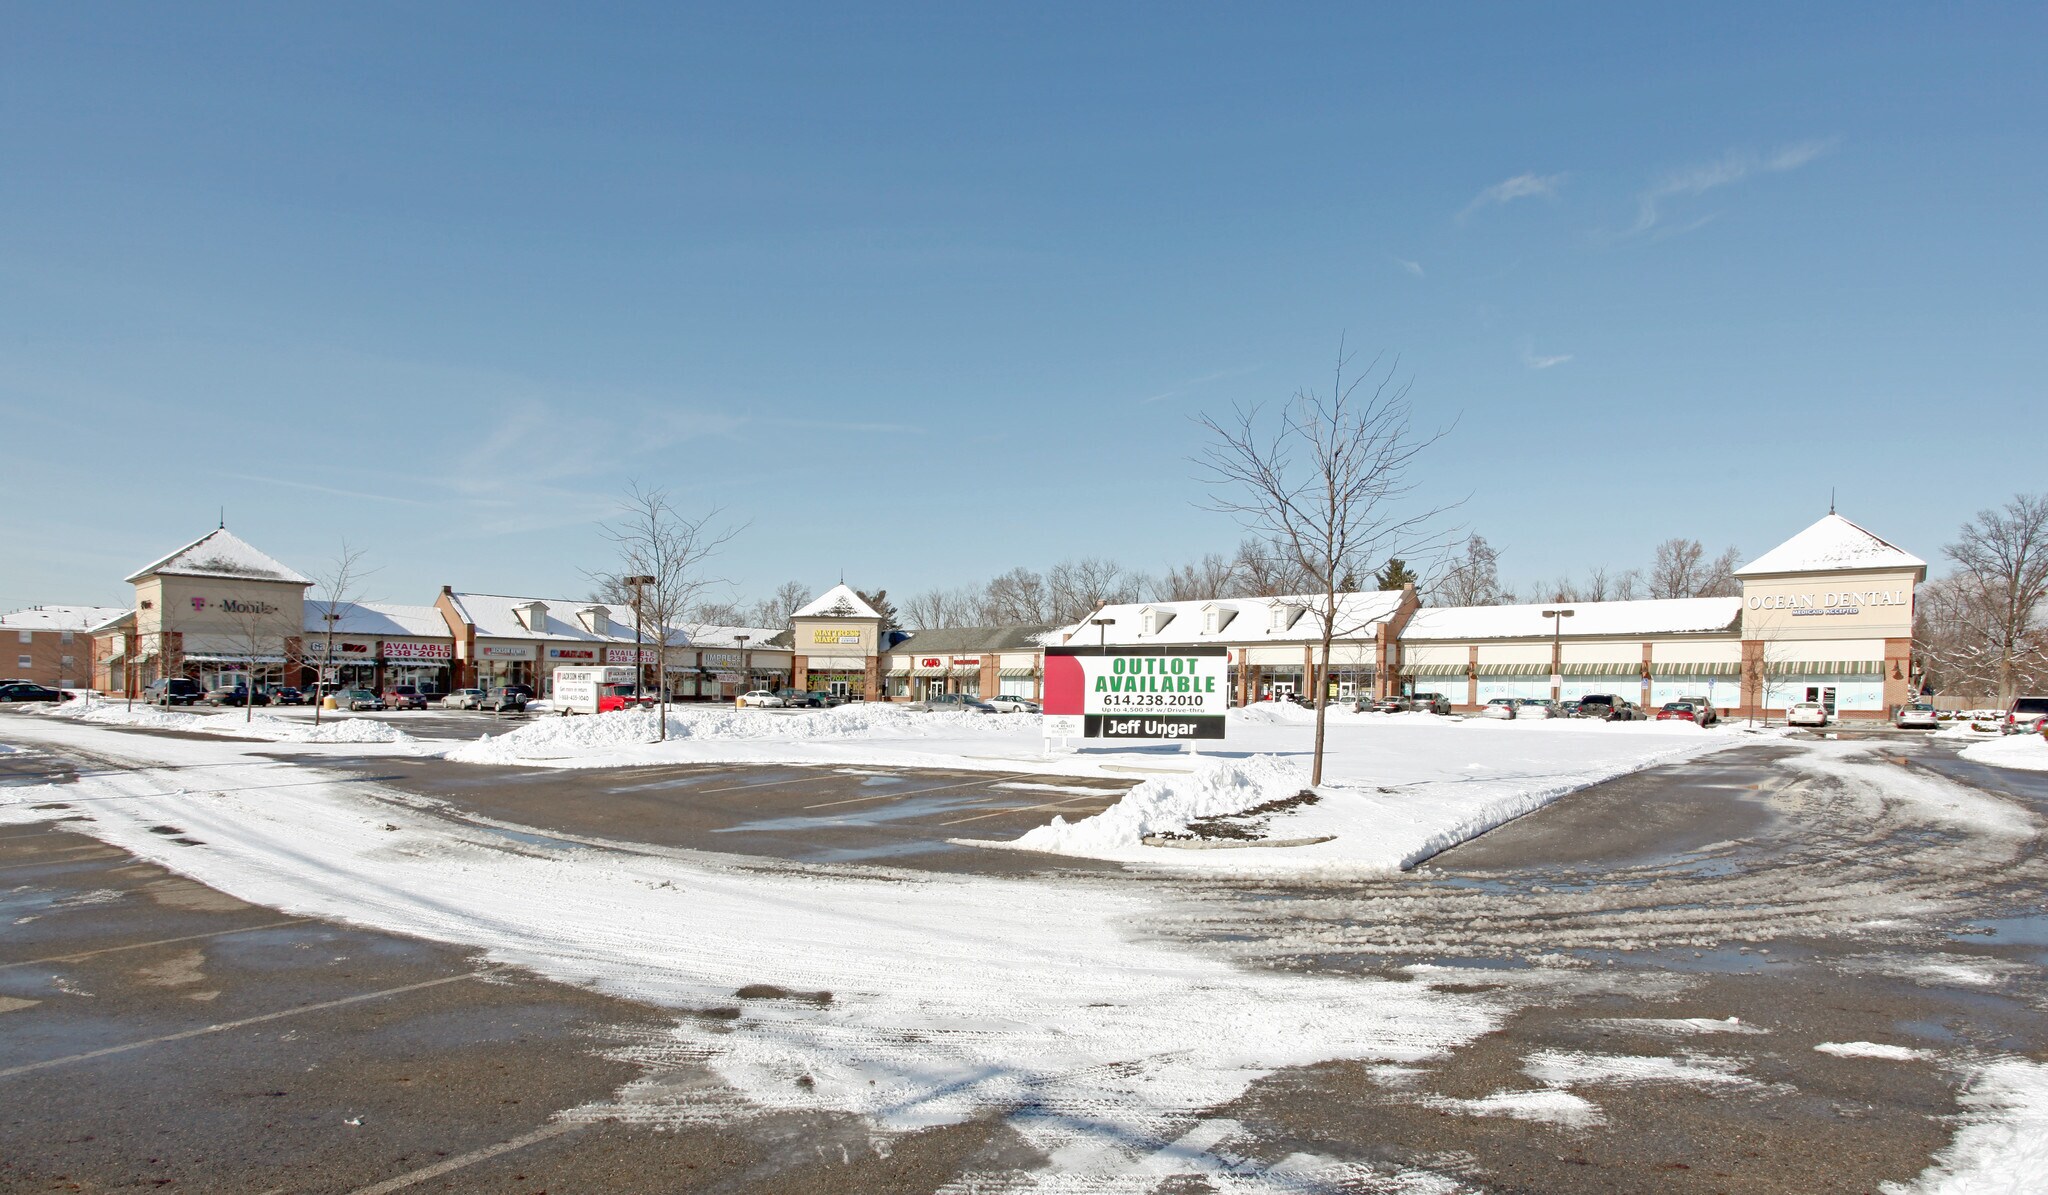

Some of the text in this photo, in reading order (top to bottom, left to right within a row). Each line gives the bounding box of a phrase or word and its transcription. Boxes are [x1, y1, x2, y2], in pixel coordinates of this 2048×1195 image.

[1747, 591, 1907, 610] OCEAN DENTAL
[814, 636, 839, 644] MART
[384, 643, 451, 651] AVAILABLE
[385, 650, 451, 658] 238-2010
[1113, 658, 1199, 675] OUTLOT
[561, 672, 591, 680] JACKSON HEWITT
[1095, 676, 1216, 693] AVAILABLE
[1103, 695, 1204, 706] 614.238.2010
[1108, 720, 1197, 737] Jeff Ungar
